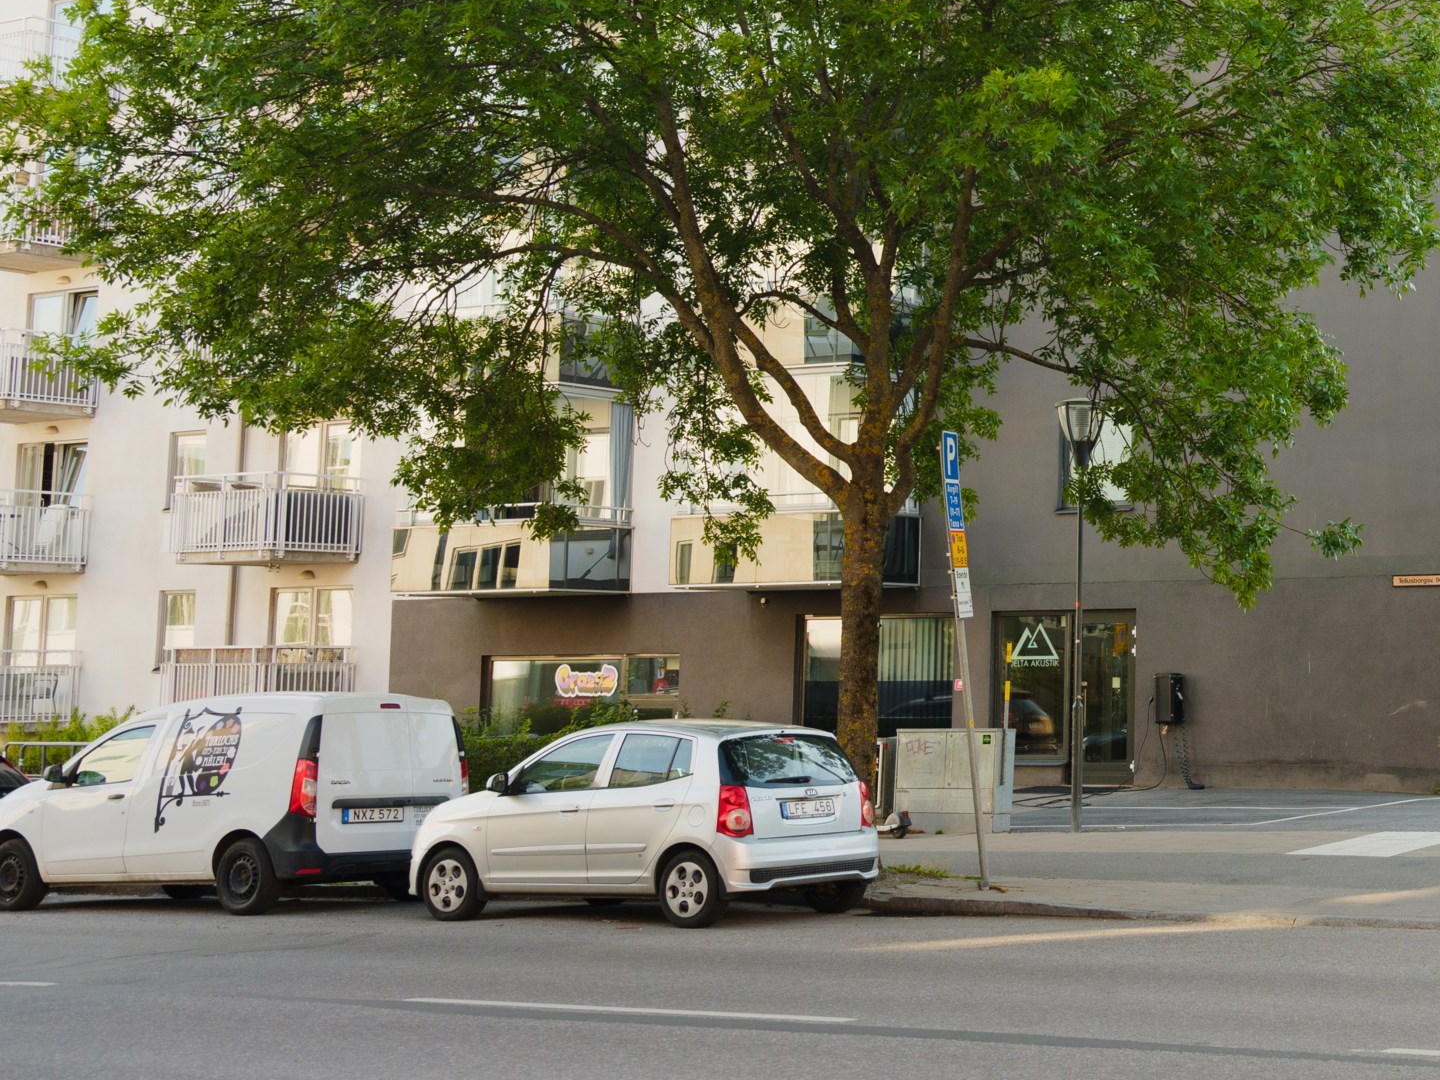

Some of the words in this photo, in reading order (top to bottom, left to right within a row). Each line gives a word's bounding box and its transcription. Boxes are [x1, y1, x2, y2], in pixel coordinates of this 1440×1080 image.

[946, 437, 956, 476] P
[1030, 660, 1060, 668] AKUSTIK
[788, 802, 807, 815] LFE
[814, 801, 832, 812] 456
[353, 809, 375, 821] NXZ
[378, 809, 399, 820] 572
